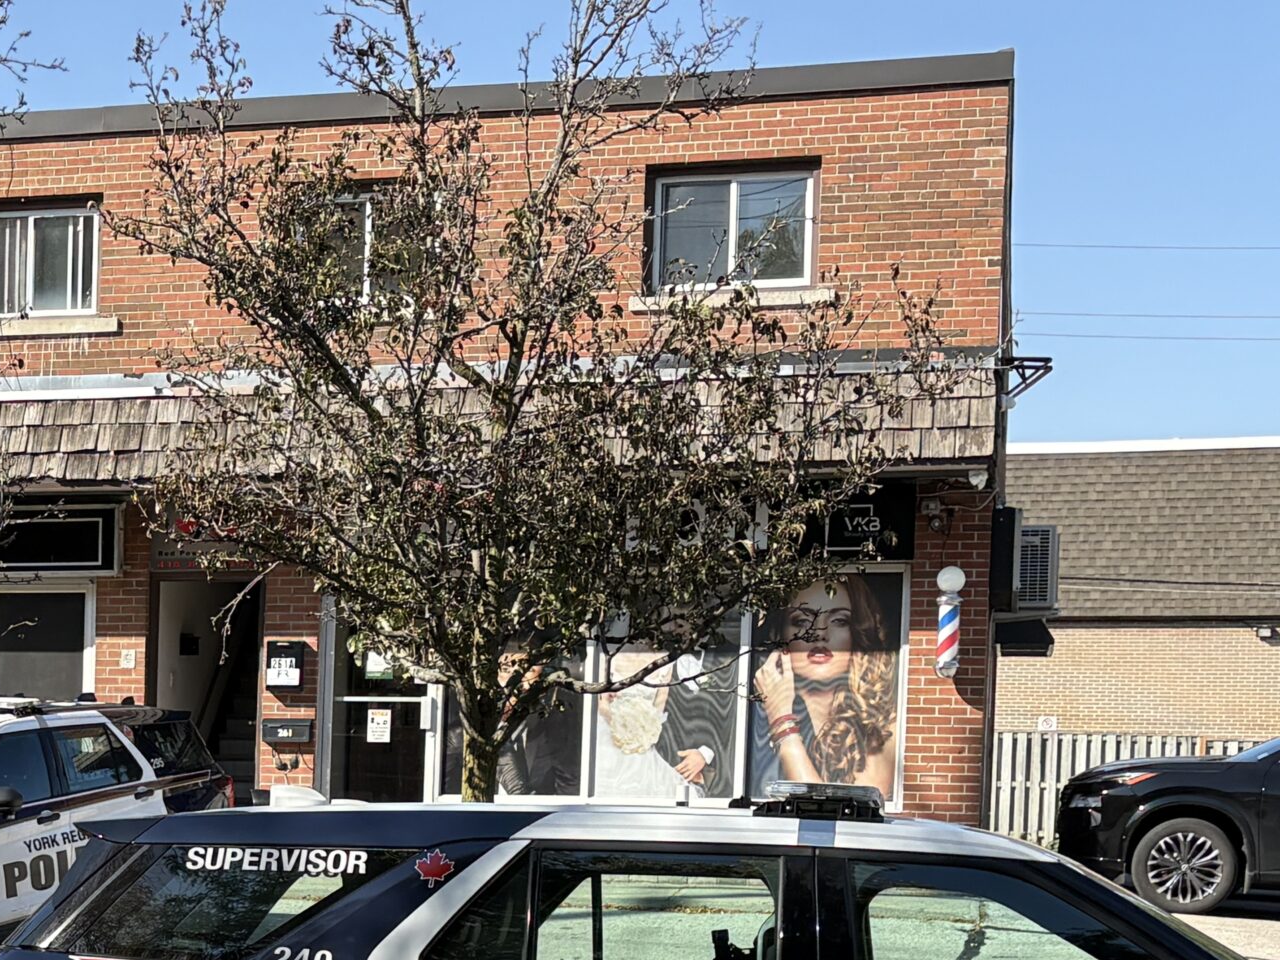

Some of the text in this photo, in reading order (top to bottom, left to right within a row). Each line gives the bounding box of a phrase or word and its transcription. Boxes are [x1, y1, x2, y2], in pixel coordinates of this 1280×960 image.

[273, 659, 295, 669] 261A
[277, 728, 292, 737] 261
[23, 834, 60, 853] YORK
[186, 847, 368, 874] SUPERVISOR
